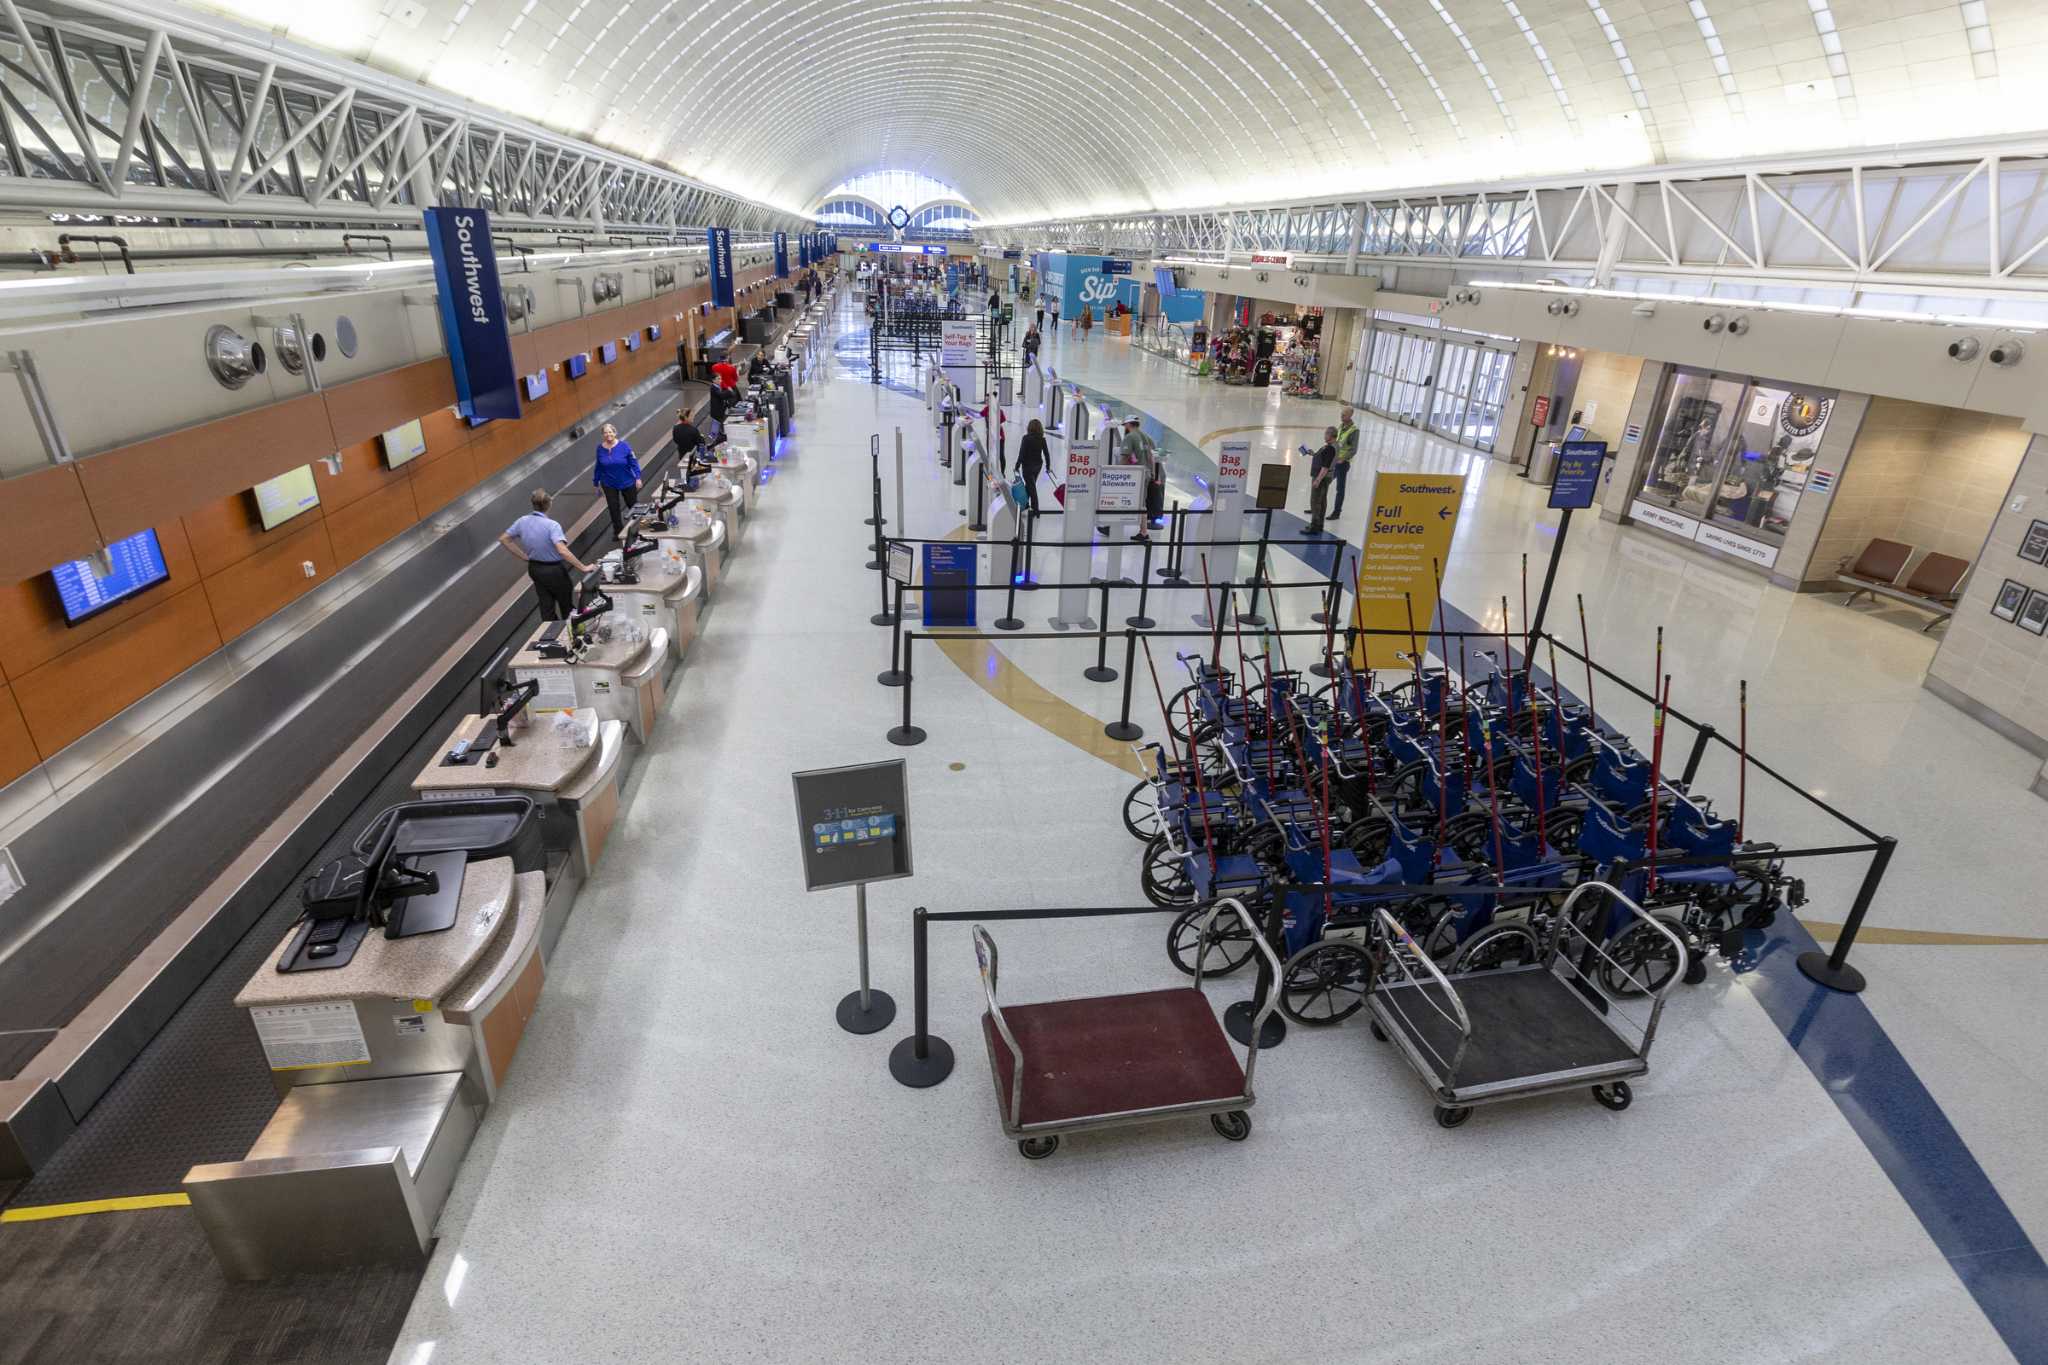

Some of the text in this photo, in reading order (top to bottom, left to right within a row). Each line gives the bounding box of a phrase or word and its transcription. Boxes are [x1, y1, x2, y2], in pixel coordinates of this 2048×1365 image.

[716, 230, 727, 278] Southwest
[455, 215, 490, 325] Southwest
[1079, 275, 1117, 304] Sip
[1070, 453, 1090, 465] Bag
[1221, 454, 1241, 466] Bag
[1069, 466, 1096, 477] Drop
[1220, 466, 1247, 478] Drop
[1399, 484, 1452, 494] Southwest
[1375, 505, 1402, 518] Full
[1373, 522, 1425, 534] Service
